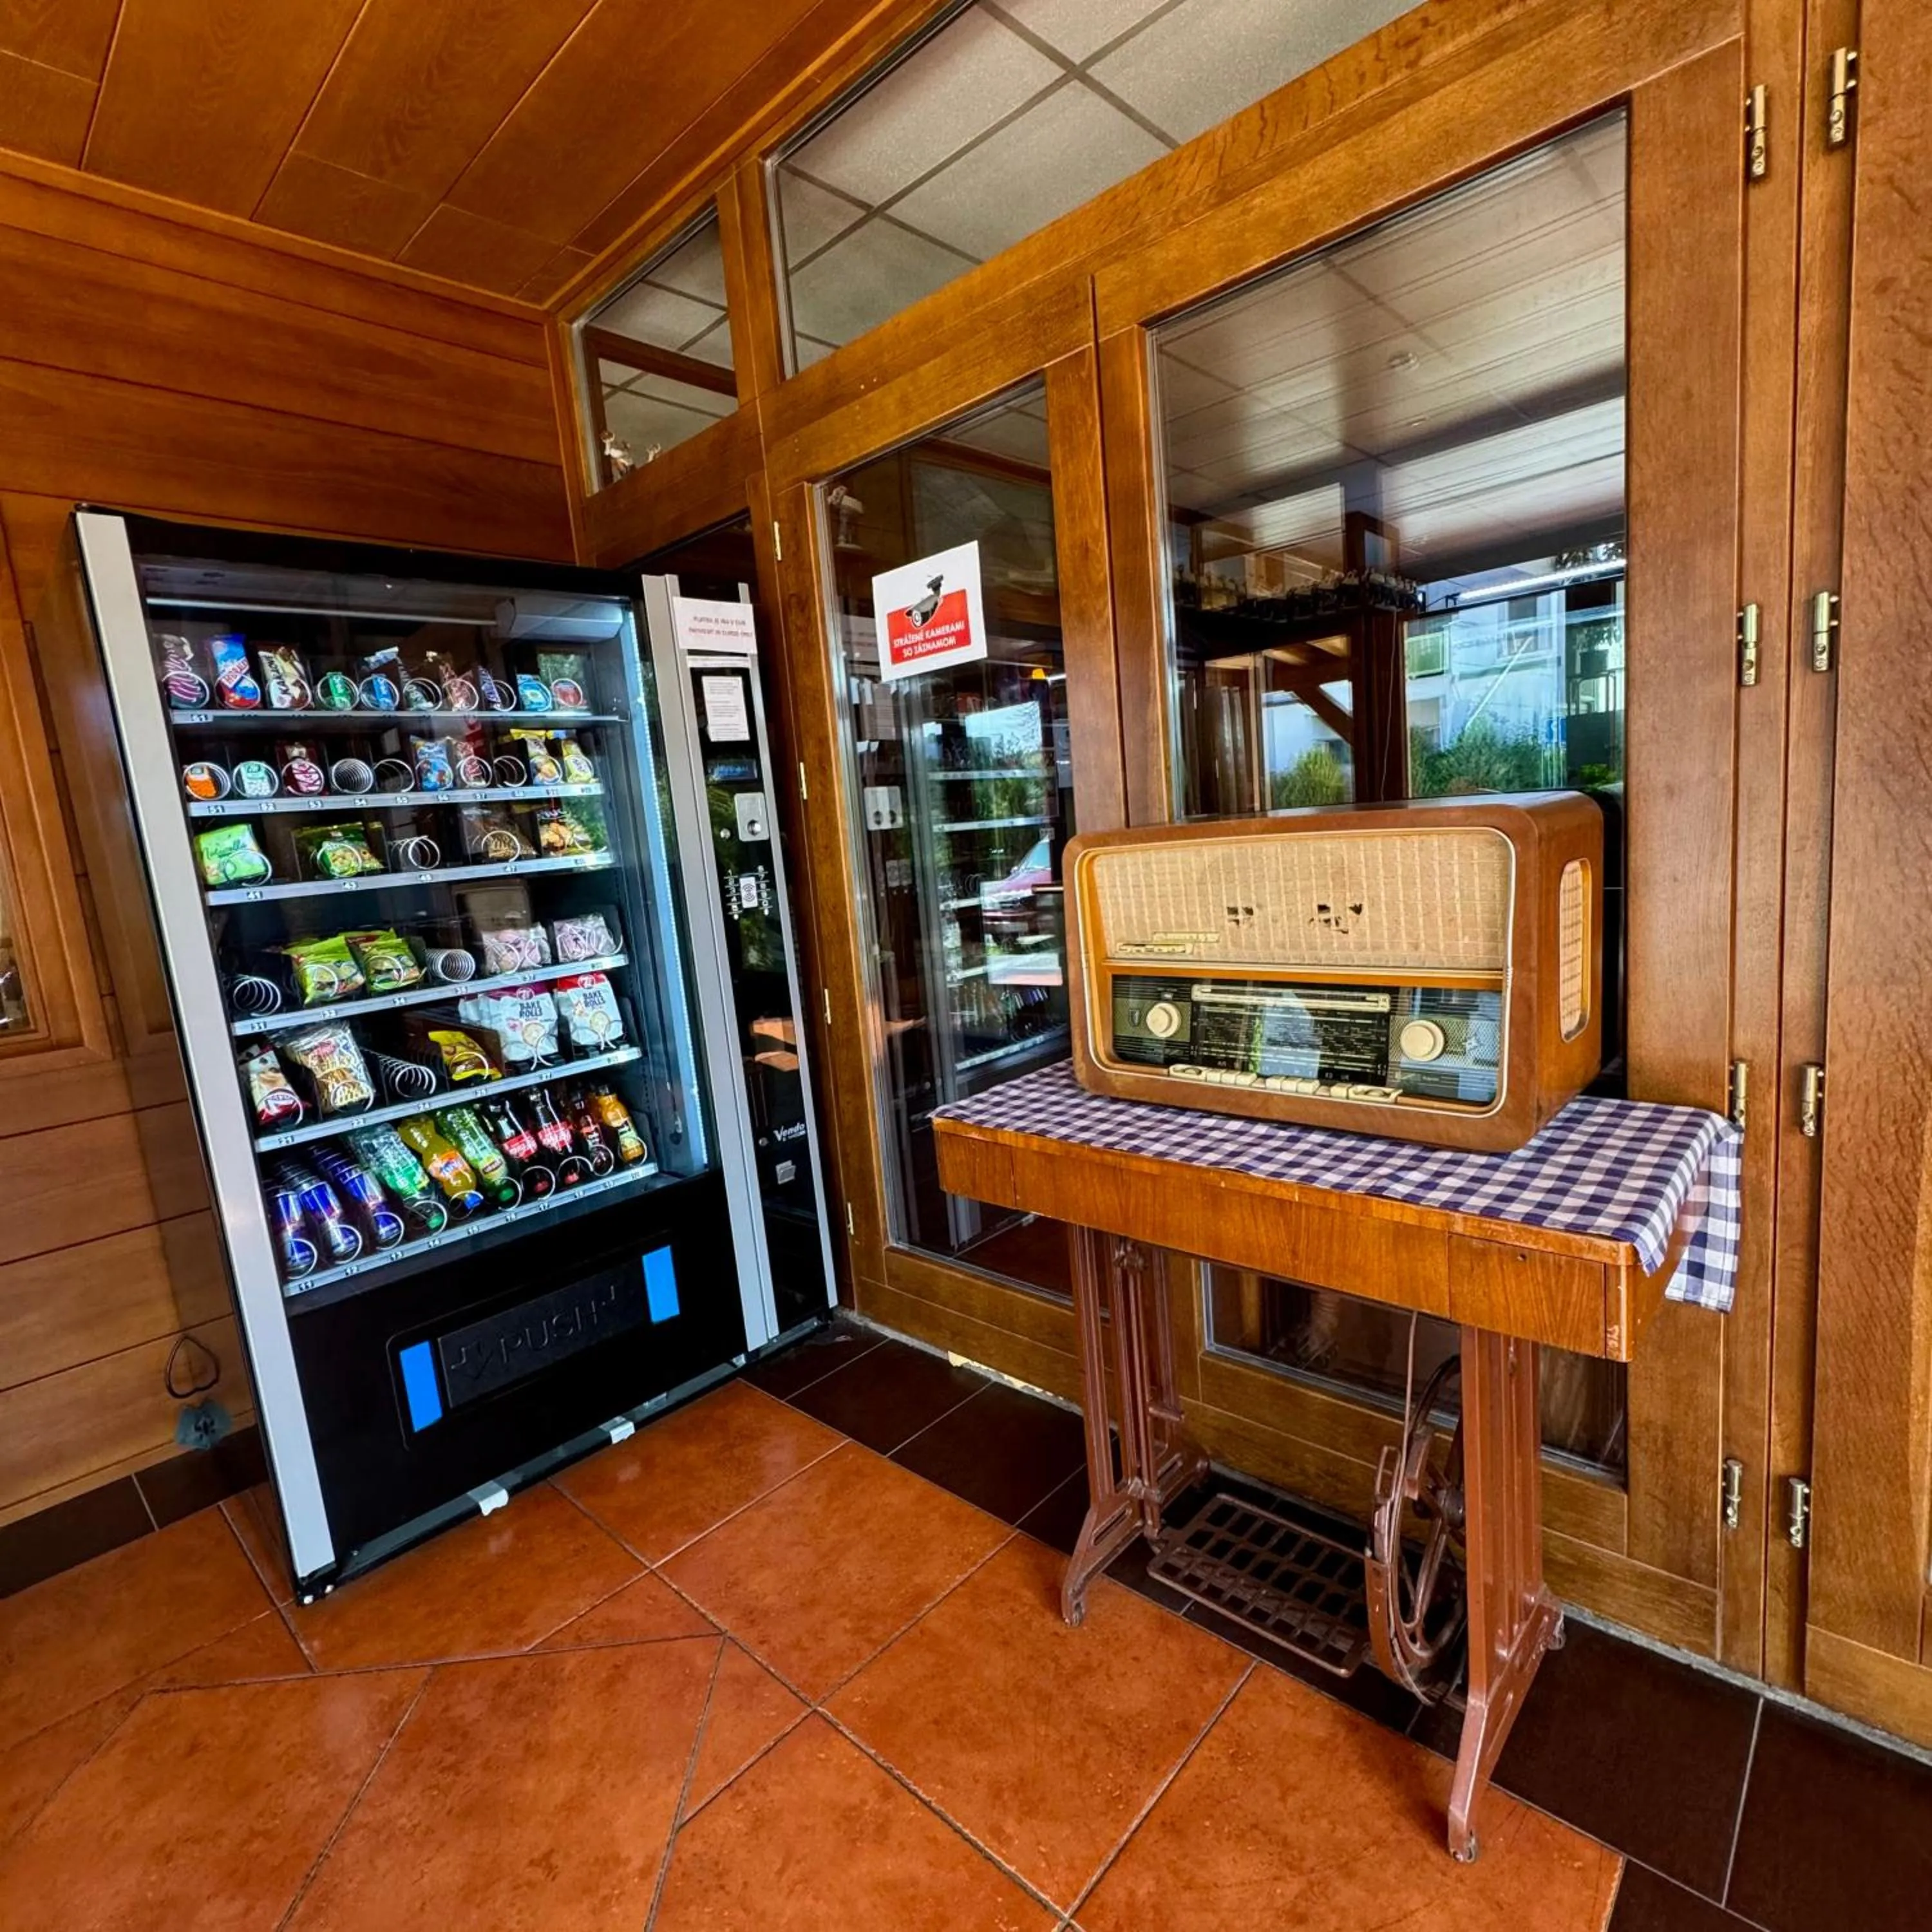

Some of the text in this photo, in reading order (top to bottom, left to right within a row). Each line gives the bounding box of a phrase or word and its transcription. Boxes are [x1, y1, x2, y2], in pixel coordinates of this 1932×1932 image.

[893, 620, 965, 649] STRÁŽENÉ KAMERAMI
[902, 636, 956, 658] SO ZÁZNAMOM
[773, 1122, 805, 1142] Vendo
[499, 1298, 599, 1364] PUSH
